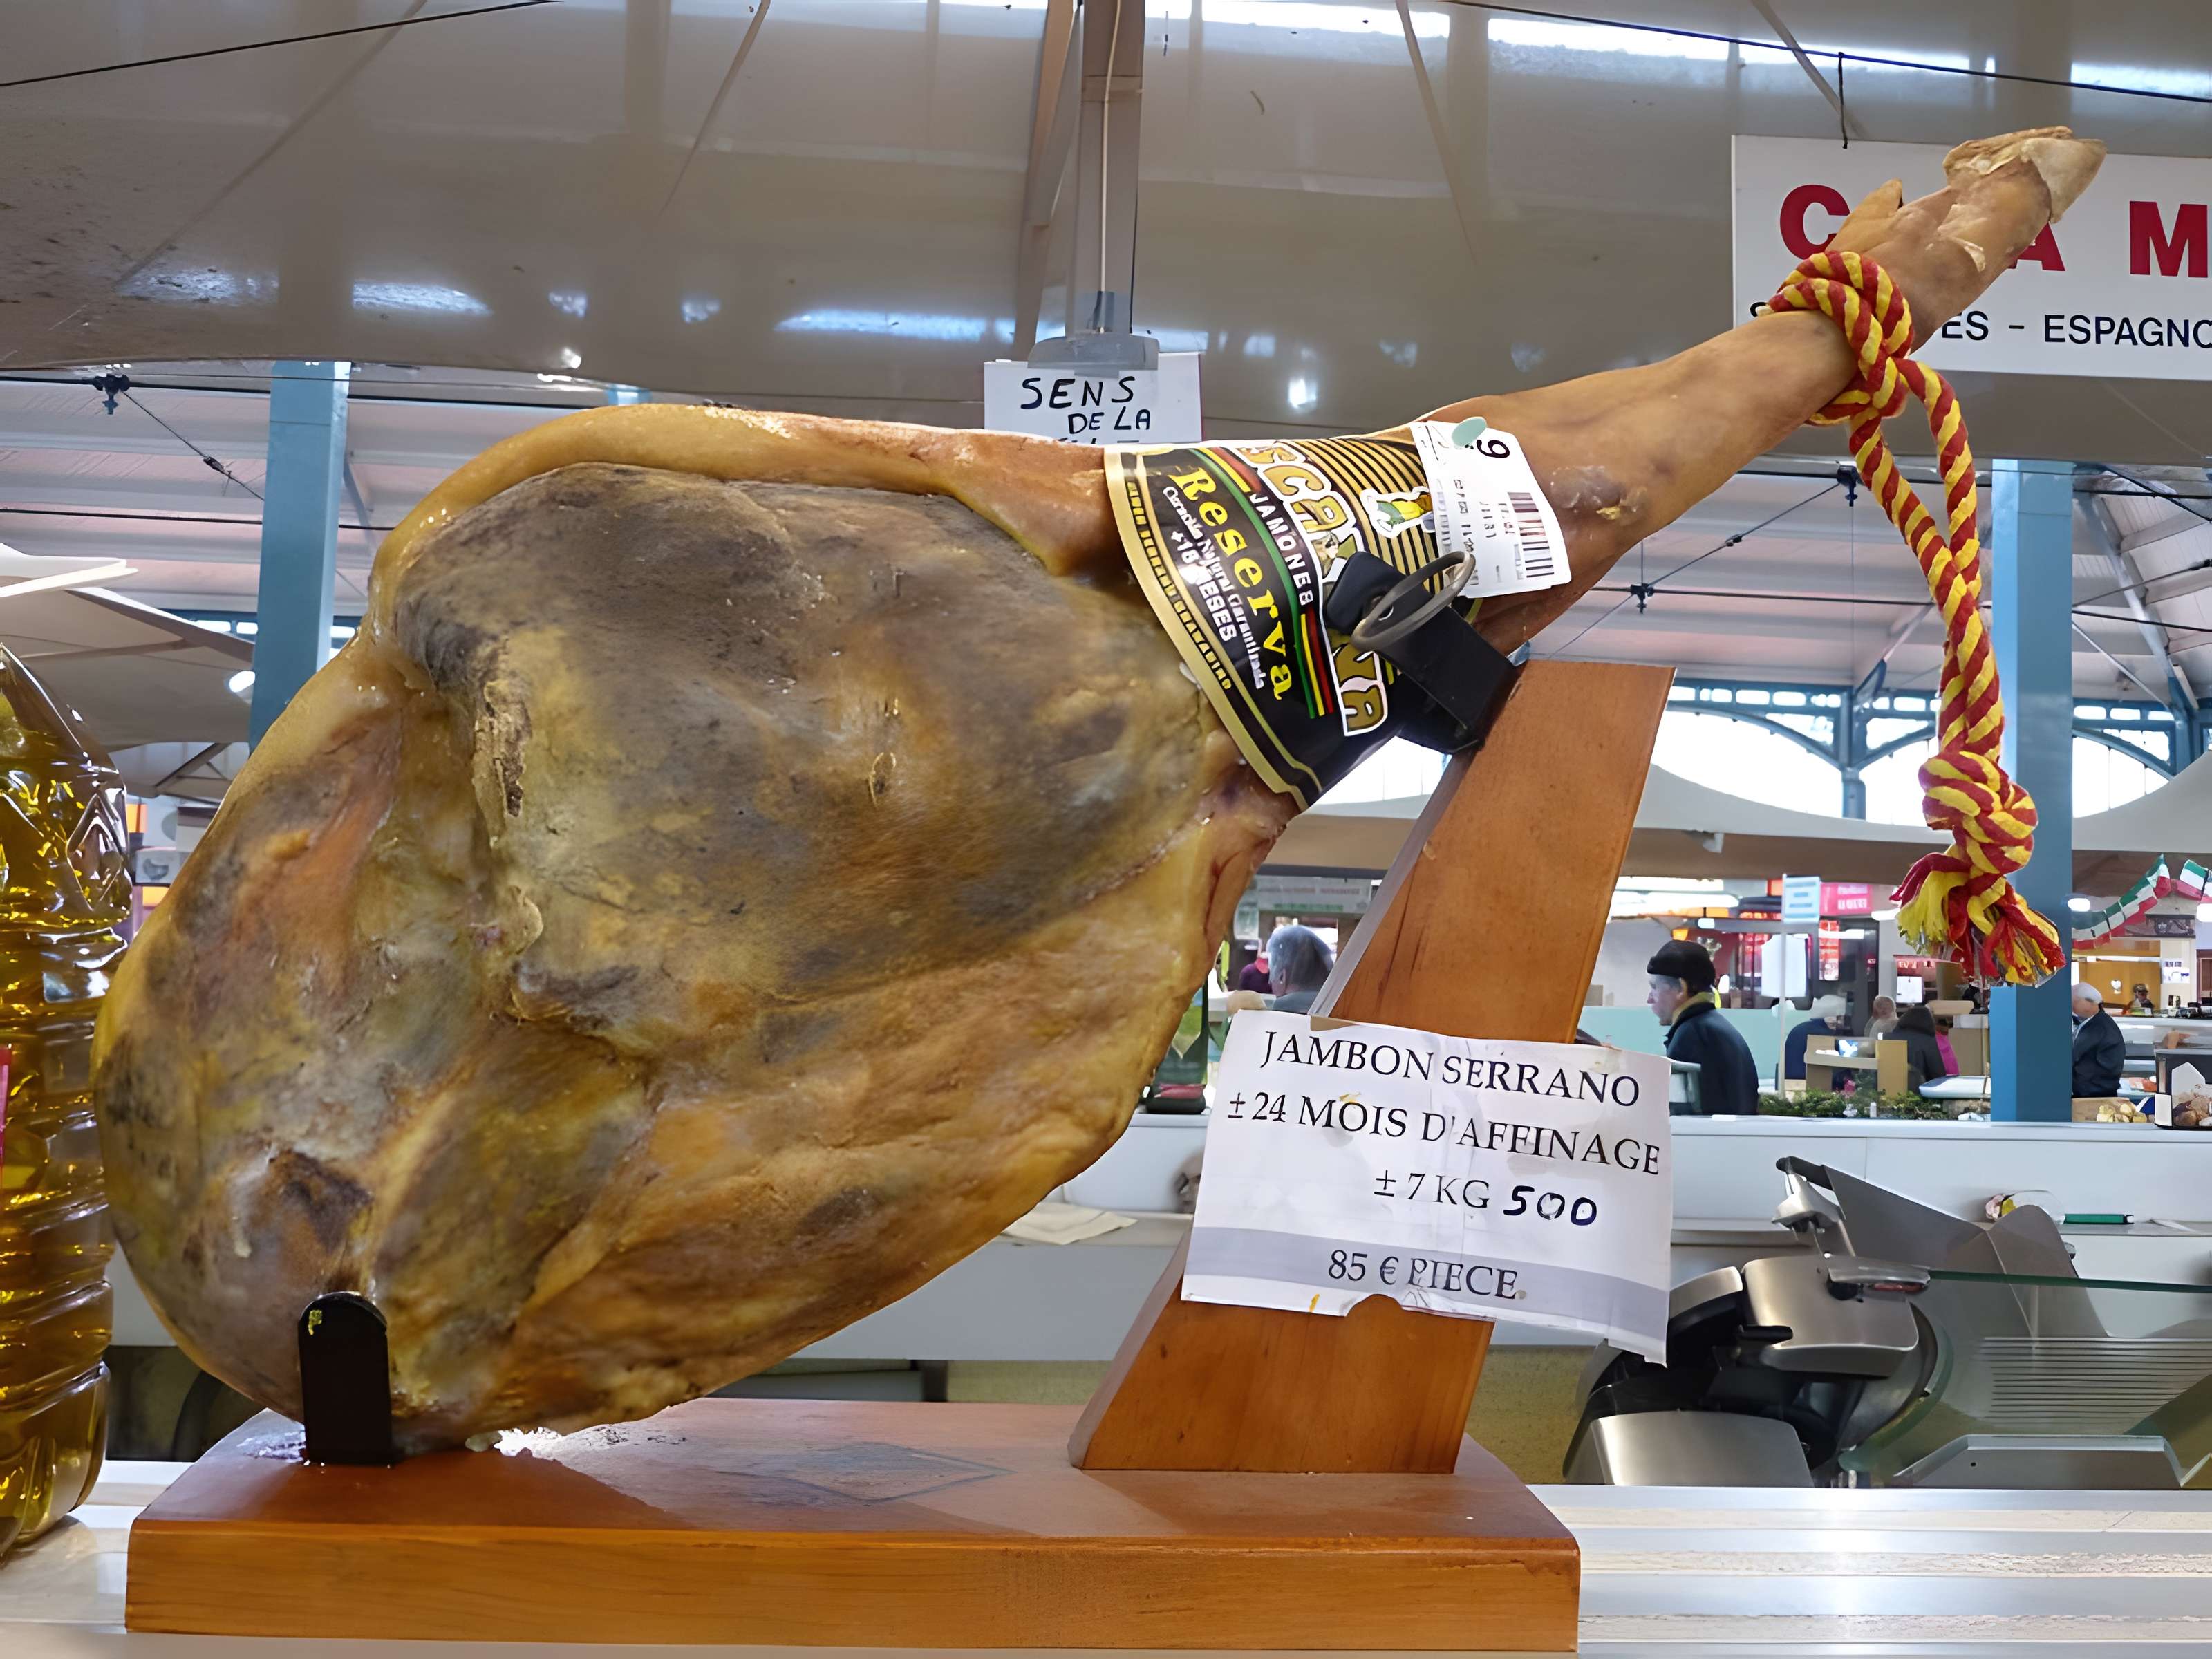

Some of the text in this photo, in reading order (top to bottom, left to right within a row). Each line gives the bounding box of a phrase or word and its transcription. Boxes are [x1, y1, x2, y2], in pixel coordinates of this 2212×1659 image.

[2044, 314, 2212, 348] ESPAGNO
[1020, 375, 1136, 409] SENS
[1068, 406, 1151, 434] DE LA
[1167, 467, 1292, 700] Reserva
[1260, 1031, 1640, 1107] JAMBON SERRANO
[1297, 1095, 1407, 1137] MOIS
[1421, 1112, 1660, 1175] D'AFFINAGE
[1433, 1174, 1489, 1208] KG
[1503, 1185, 1597, 1226] 500
[1328, 1250, 1367, 1281] 85
[1407, 1258, 1518, 1300] PIECE
